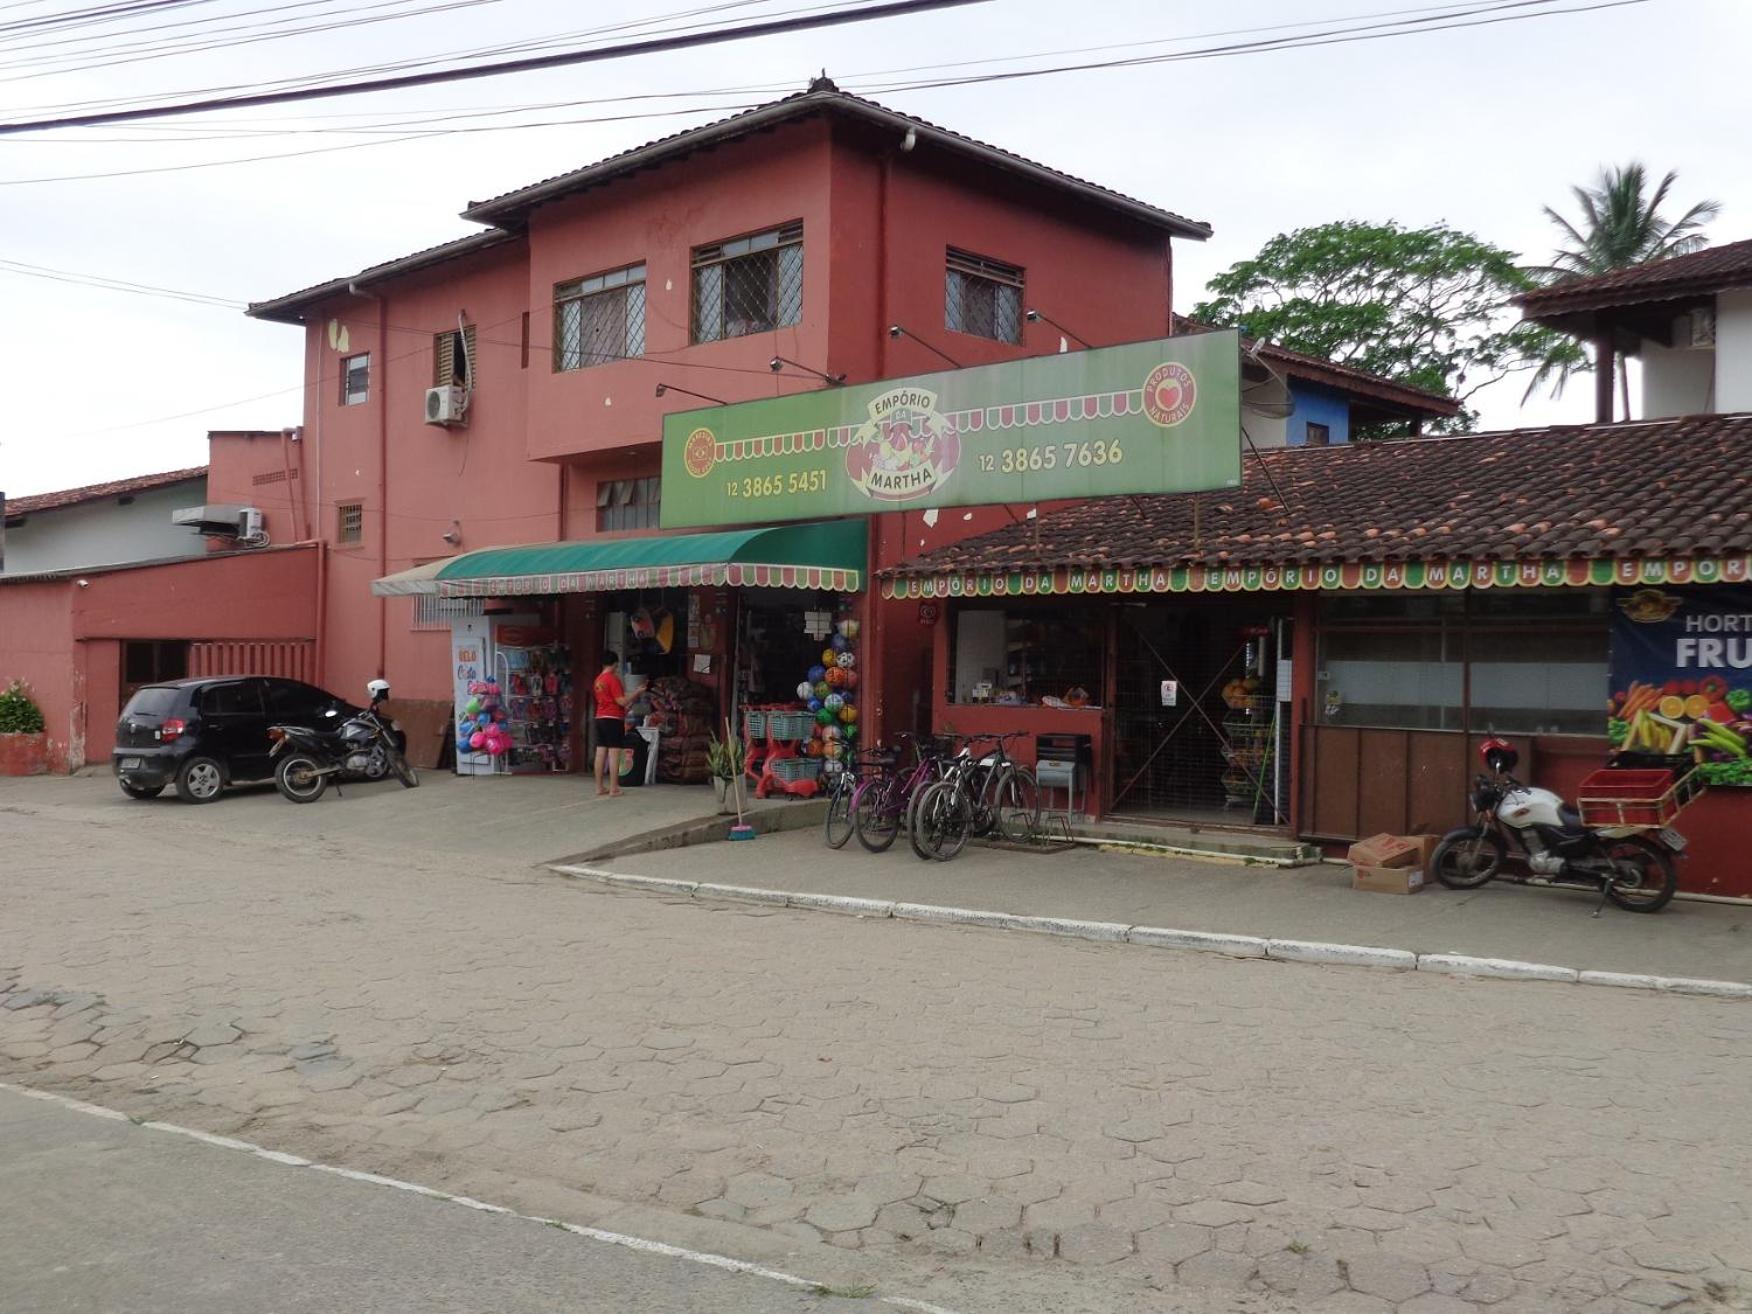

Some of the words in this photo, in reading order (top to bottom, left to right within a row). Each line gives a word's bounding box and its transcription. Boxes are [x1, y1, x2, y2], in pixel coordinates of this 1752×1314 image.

[1147, 366, 1191, 392] PRODUTOS
[875, 390, 931, 414] EMPÓRIO
[1149, 402, 1190, 424] NATURAIS
[978, 454, 995, 472] 12
[1001, 446, 1057, 473] 3865
[1063, 439, 1123, 468] 7636
[727, 482, 738, 496] 12
[743, 474, 783, 497] 3865
[788, 470, 827, 493] 5451
[871, 467, 932, 490] MARTHA
[911, 577, 1004, 593] EMPÓRIO
[1025, 577, 1049, 589] DA
[1071, 573, 1166, 588] MARTHA
[1366, 568, 1399, 581] DA
[1429, 565, 1560, 581] MARTHA
[1685, 614, 1752, 633] HORT
[1676, 638, 1752, 669] FRU
